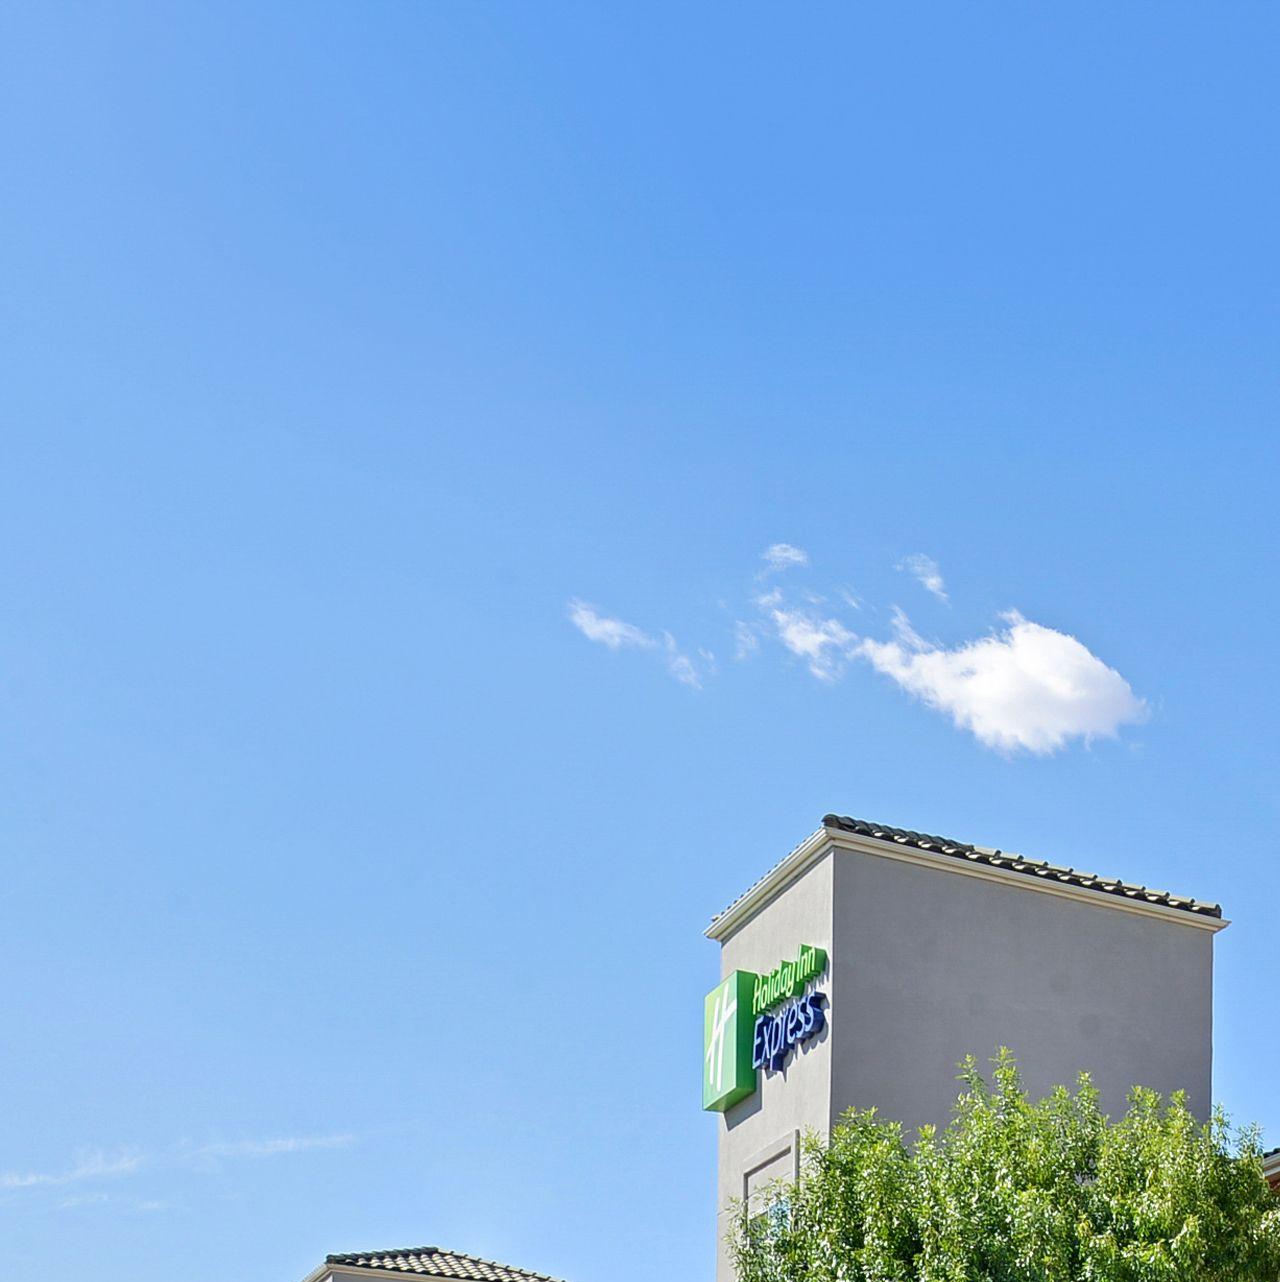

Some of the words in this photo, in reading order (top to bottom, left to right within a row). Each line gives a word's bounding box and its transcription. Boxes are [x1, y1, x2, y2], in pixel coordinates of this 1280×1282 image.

[753, 962, 796, 1015] Holiday
[796, 944, 816, 982] Inn
[752, 992, 816, 1071] Express
